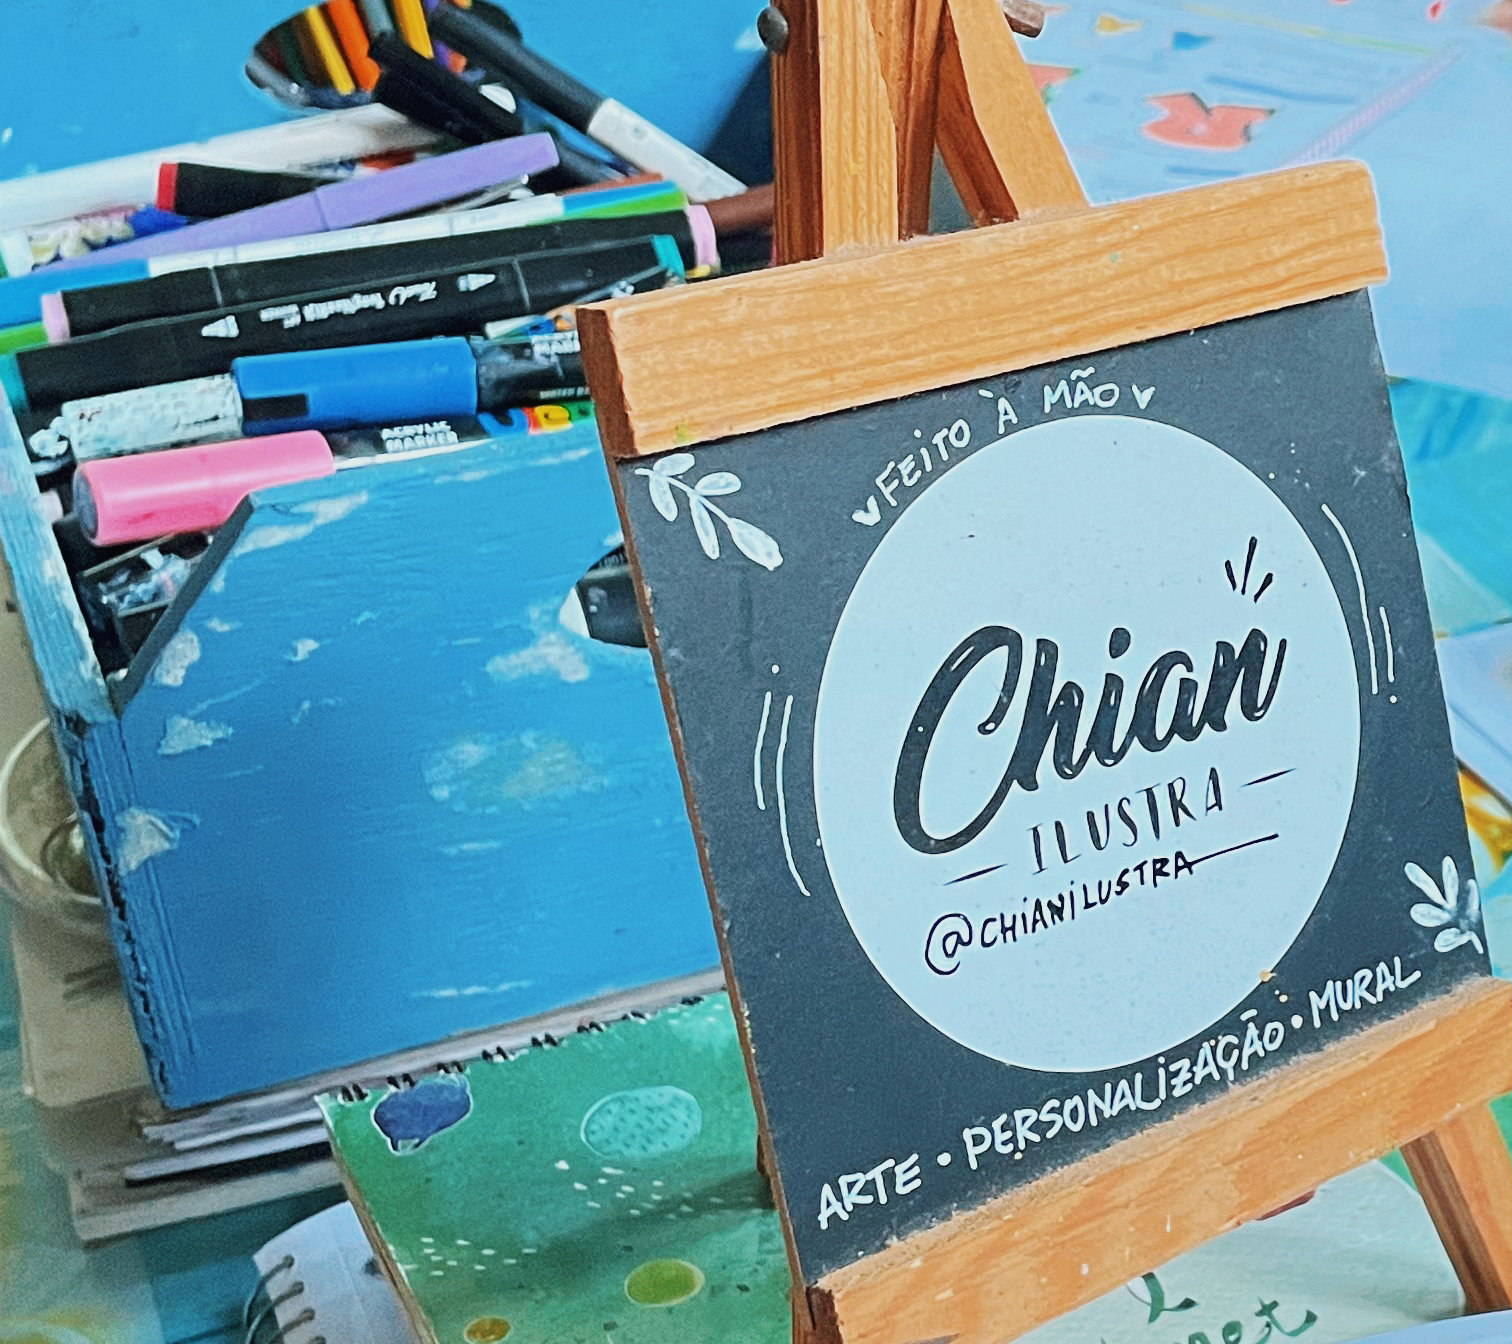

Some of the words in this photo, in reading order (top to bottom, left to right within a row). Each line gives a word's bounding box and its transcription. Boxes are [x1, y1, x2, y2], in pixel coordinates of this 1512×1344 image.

[386, 430, 460, 454] MARKER
[875, 418, 972, 508] FEITO
[977, 388, 1019, 435] À
[1043, 366, 1121, 414] MÃO
[893, 625, 1288, 854] Chian
[1026, 767, 1224, 875] ILUSTRA
[817, 1153, 922, 1230] ARTE
[962, 1008, 1286, 1170] PERSONALIZAÇÃO
[1307, 955, 1422, 1029] MURAL
